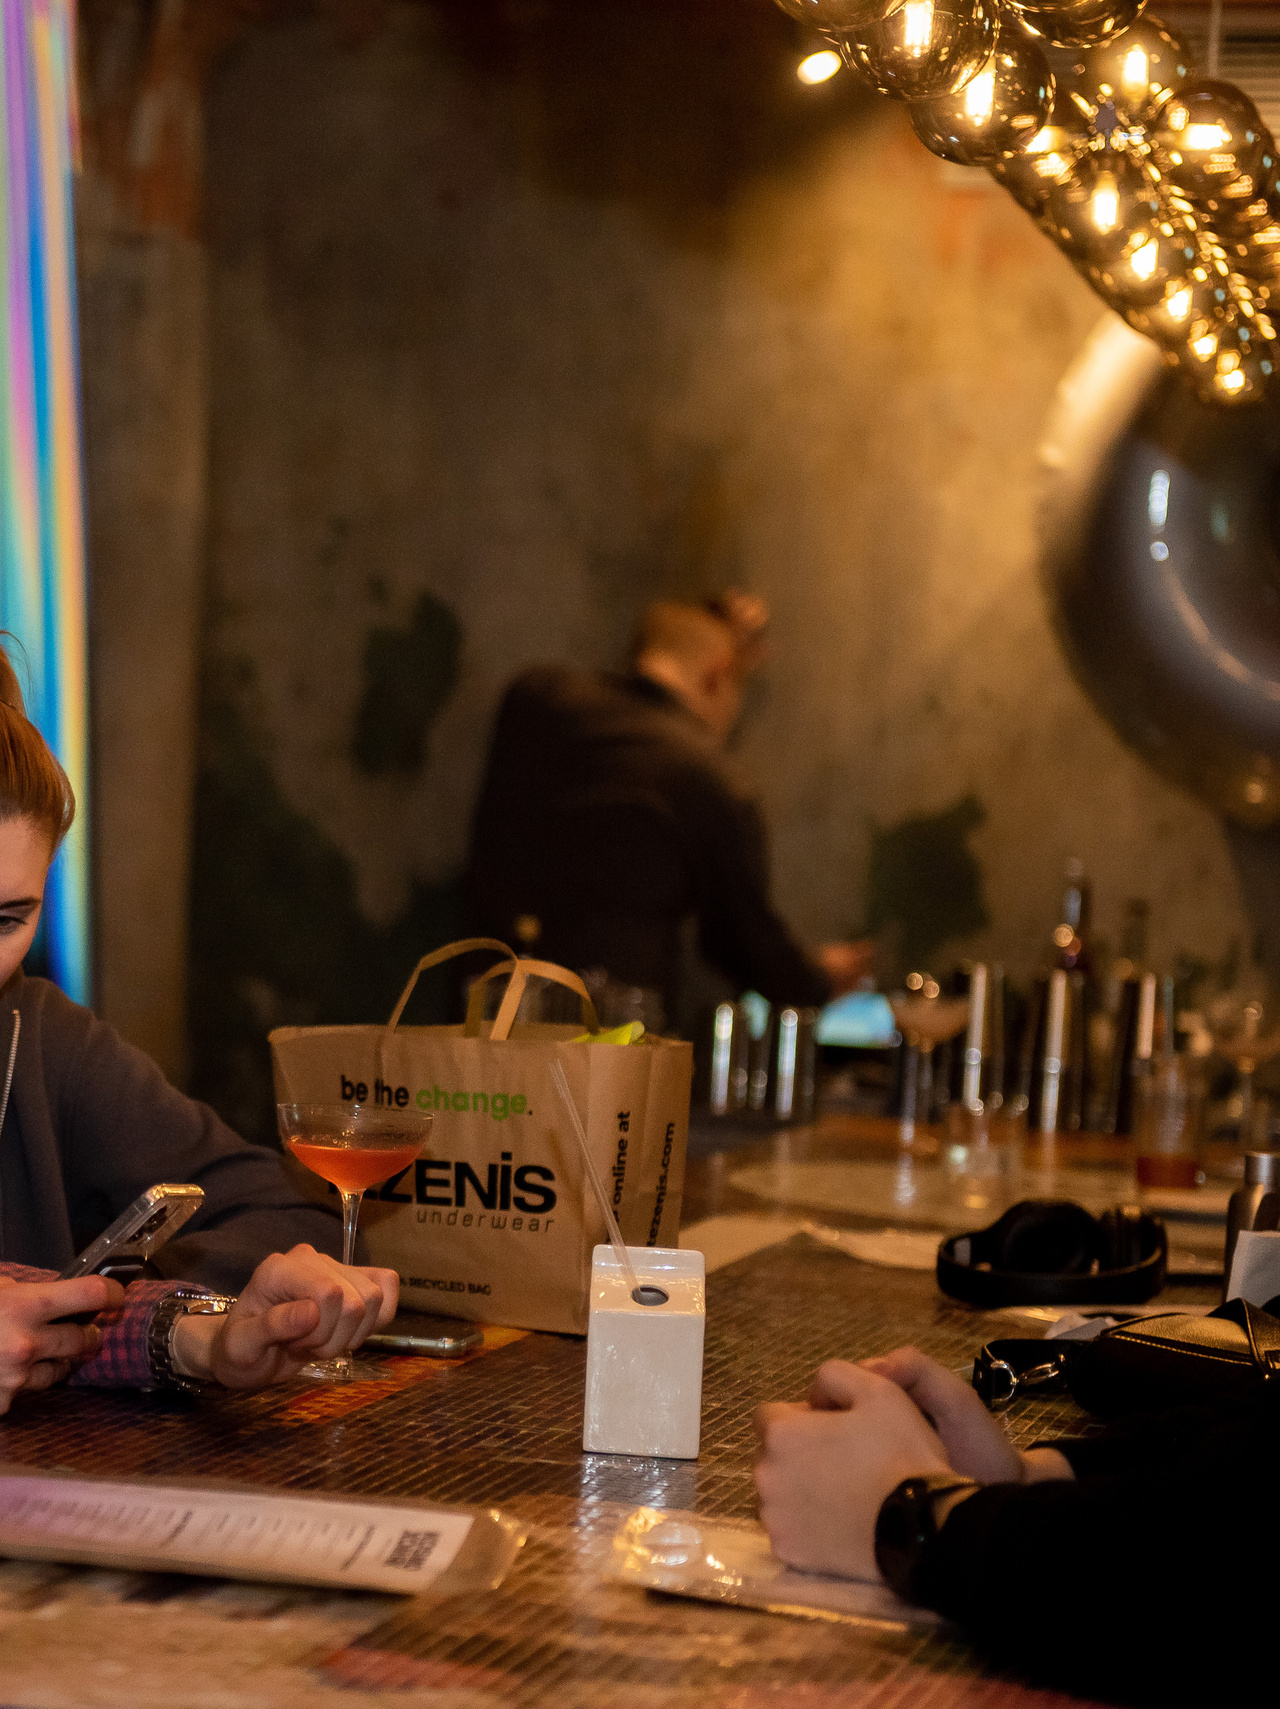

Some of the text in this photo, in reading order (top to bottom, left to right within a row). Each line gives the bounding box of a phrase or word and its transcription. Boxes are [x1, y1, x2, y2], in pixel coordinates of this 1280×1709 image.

[340, 1074, 533, 1121] be the change.
[617, 1110, 631, 1132] at
[611, 1139, 628, 1205] online
[416, 1207, 555, 1233] underwear
[409, 1277, 466, 1294] RECYCLED
[467, 1283, 491, 1296] BAG
